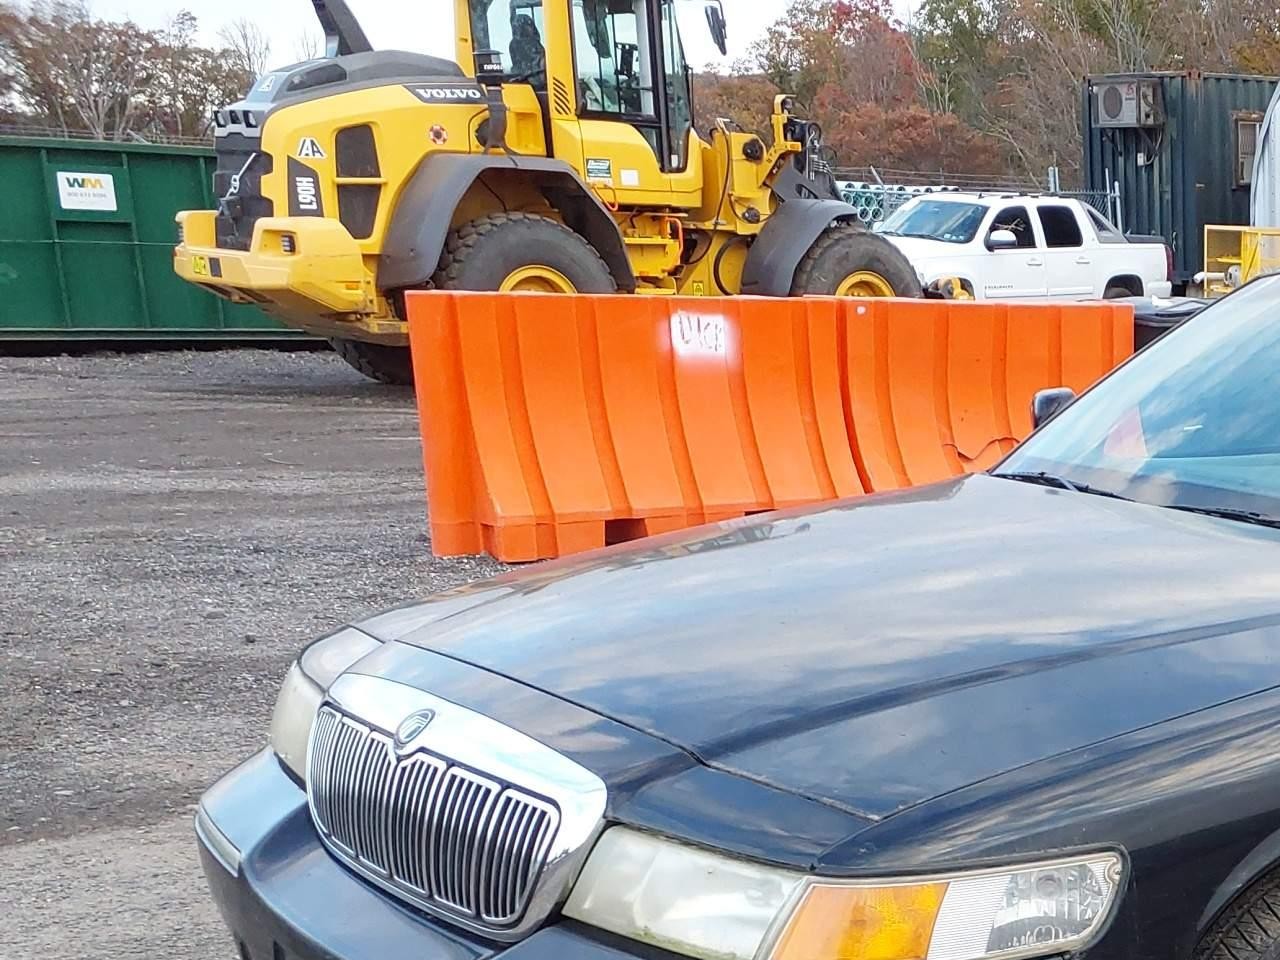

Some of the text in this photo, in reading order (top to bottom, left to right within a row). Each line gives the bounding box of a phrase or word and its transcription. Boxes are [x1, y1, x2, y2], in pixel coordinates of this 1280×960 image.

[416, 88, 481, 98] VOLVO
[65, 177, 104, 189] WM
[295, 176, 318, 210] L90H
